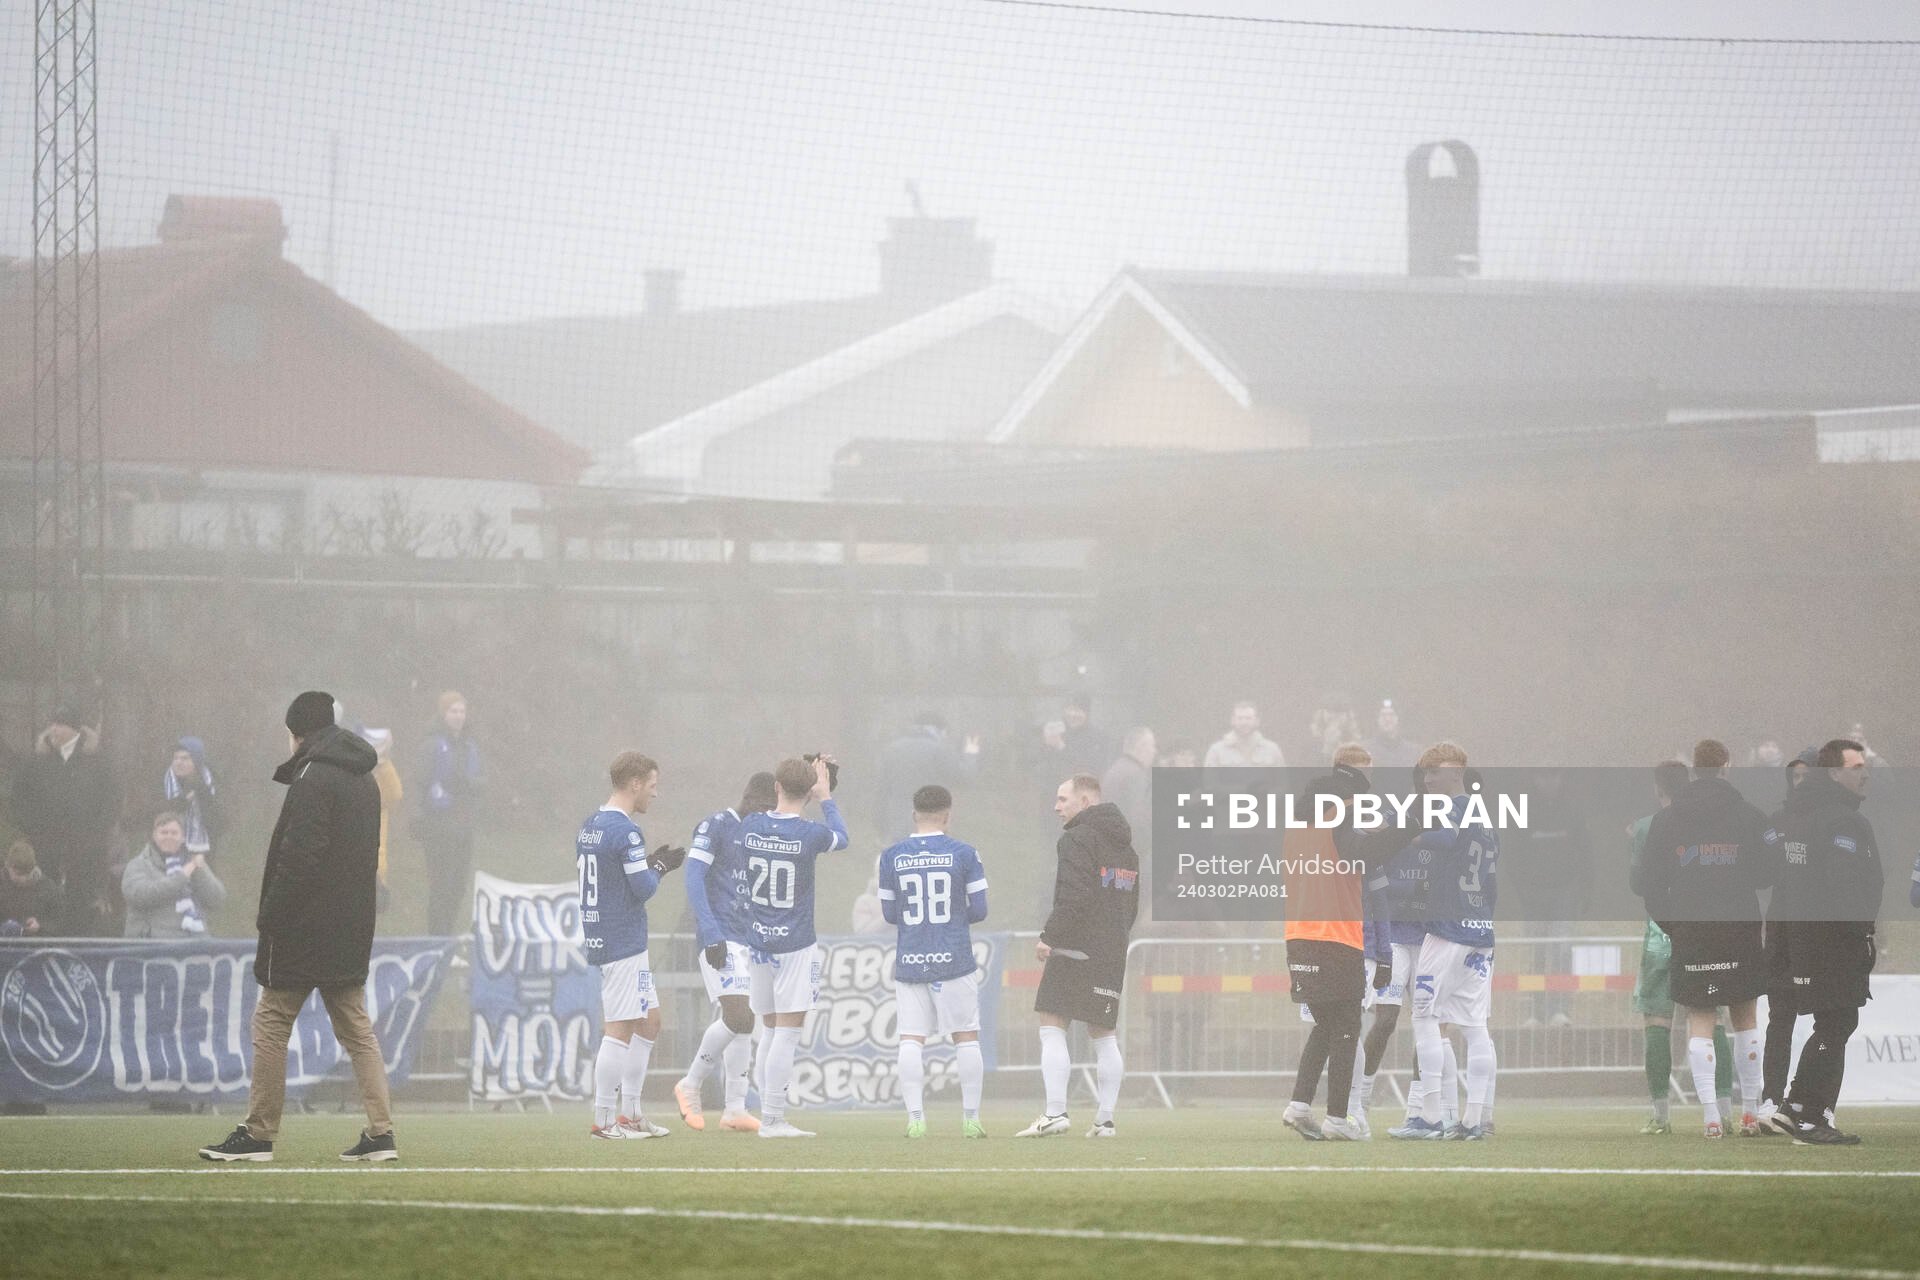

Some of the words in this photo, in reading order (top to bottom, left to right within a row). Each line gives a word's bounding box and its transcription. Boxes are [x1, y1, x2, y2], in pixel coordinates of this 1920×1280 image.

[577, 854, 598, 906] 19
[749, 857, 796, 909] 20
[898, 871, 952, 926] 38
[902, 954, 925, 965] noc
[926, 952, 952, 963] noc
